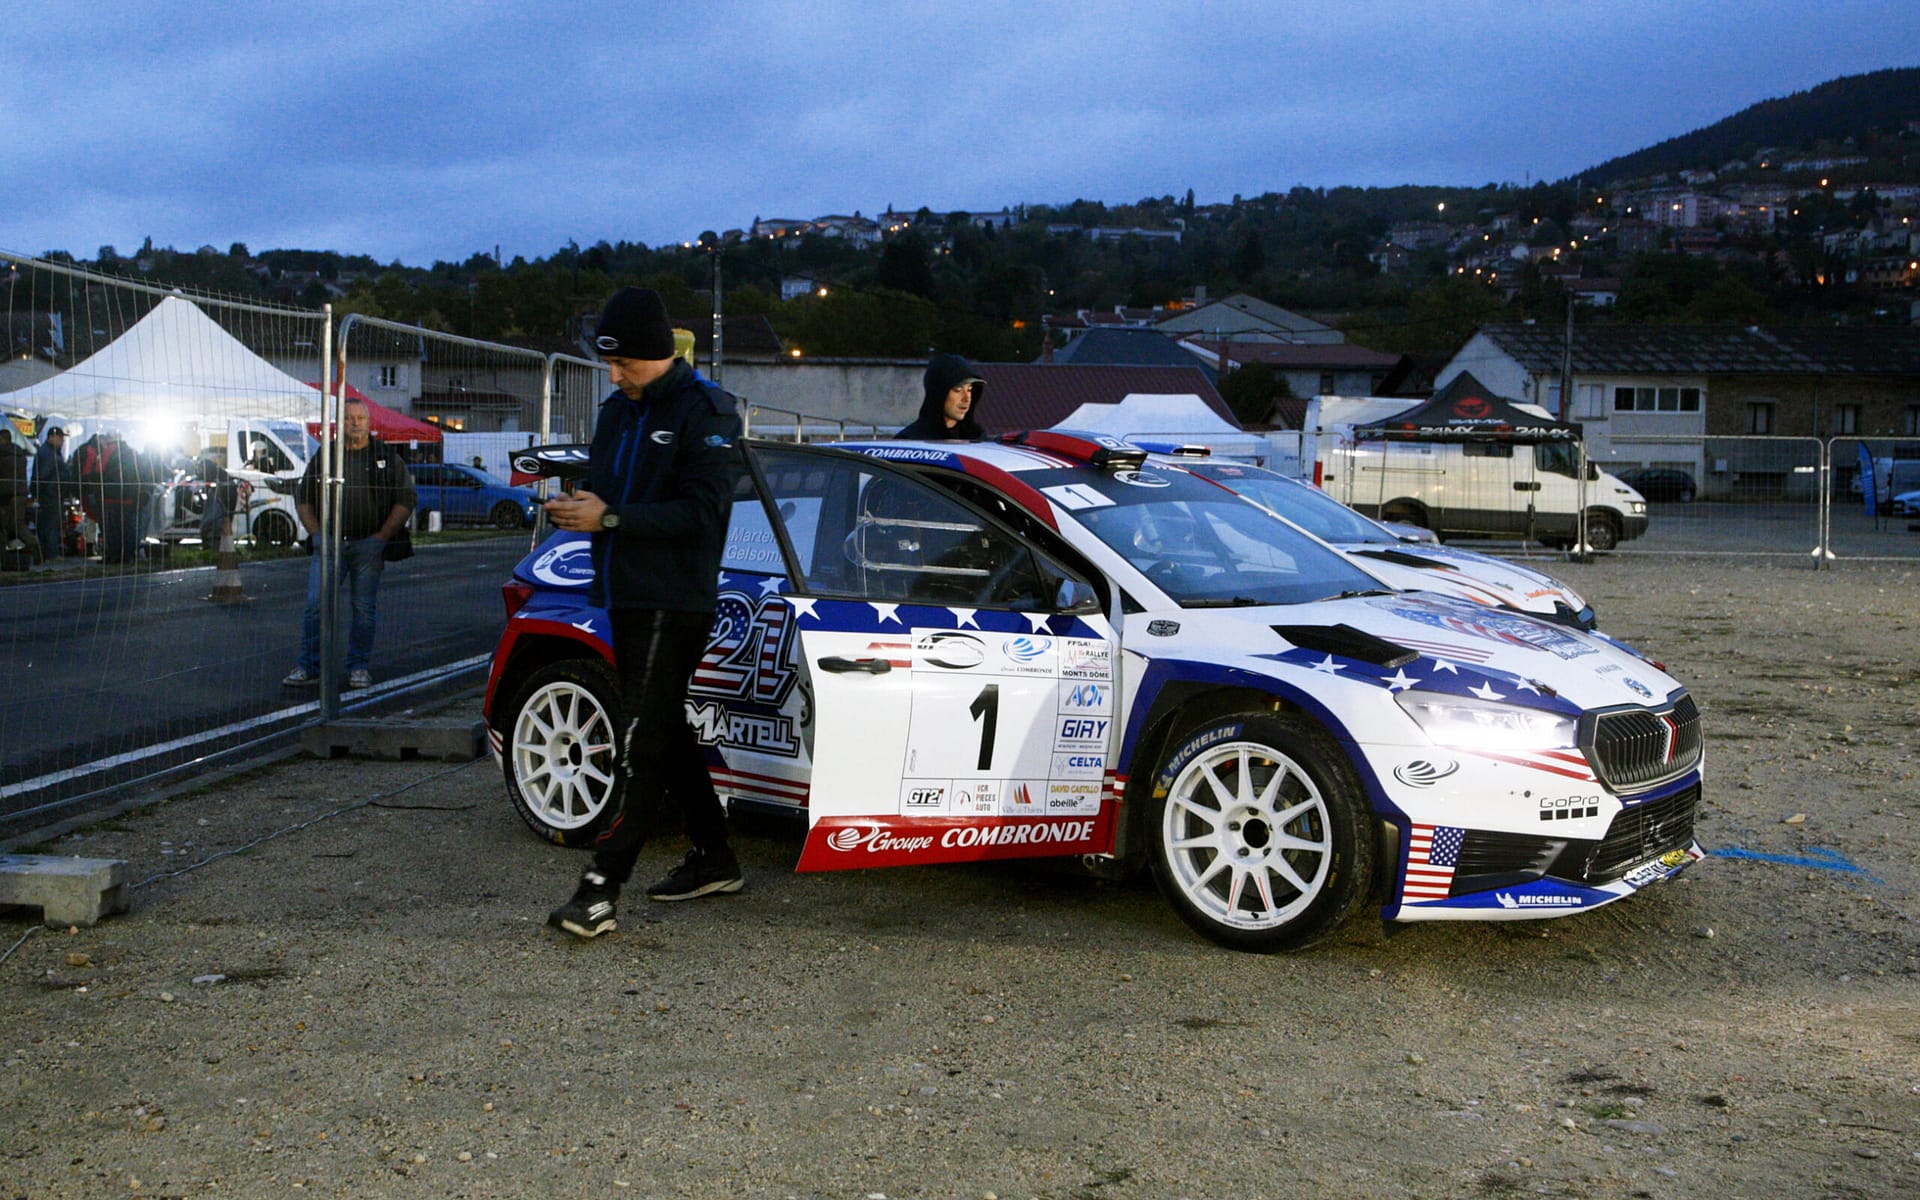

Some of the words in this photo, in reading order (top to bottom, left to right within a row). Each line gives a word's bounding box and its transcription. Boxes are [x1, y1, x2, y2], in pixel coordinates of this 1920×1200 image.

[1420, 426, 1475, 436] 24MX
[1515, 426, 1570, 438] 24MX
[864, 447, 951, 460] COMBRONDE
[1085, 650, 1109, 658] RALLYE
[969, 683, 999, 771] 1
[1061, 719, 1108, 739] GIRY
[1168, 726, 1237, 771] MICHELIN
[1068, 756, 1103, 768] CELTA
[1050, 785, 1069, 793] DAVID
[1071, 785, 1099, 794] CASTILLO
[975, 793, 996, 802] PIECES
[1049, 799, 1078, 808] abeille
[1539, 795, 1600, 809] GoPro
[975, 803, 991, 811] AUTO
[867, 831, 934, 853] Groupe
[940, 821, 1096, 849] COMBRONDE
[1518, 895, 1582, 905] MICHELIN
